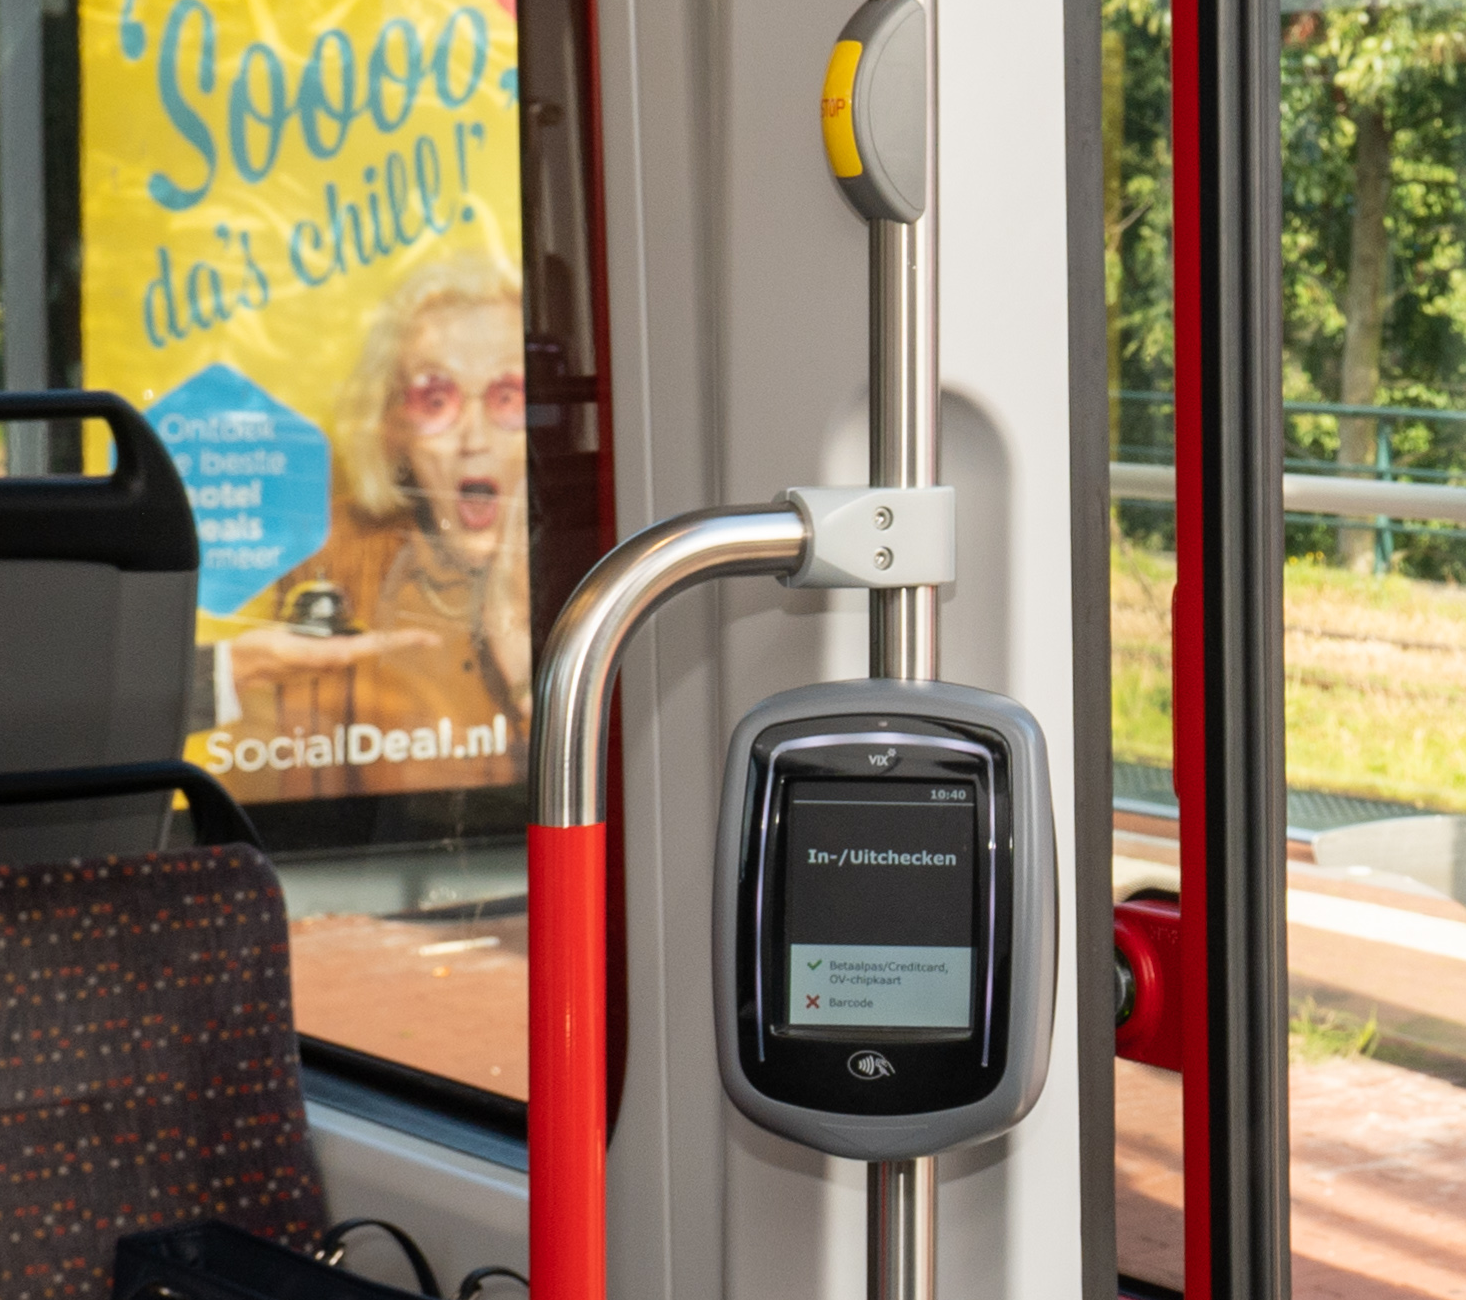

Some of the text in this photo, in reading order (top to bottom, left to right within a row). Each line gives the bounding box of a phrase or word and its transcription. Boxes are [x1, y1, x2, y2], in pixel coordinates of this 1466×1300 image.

[142, 222, 271, 350] da's
[200, 447, 287, 476] beste
[198, 512, 264, 543] eals
[203, 546, 283, 571] meer
[205, 712, 508, 775] SocialDeal.nl
[868, 754, 890, 766] VIX
[930, 788, 967, 800] 10:40
[807, 848, 957, 867] In-/Uitchecken
[829, 960, 949, 974] Betaalpas/Creditcard,
[829, 974, 902, 986] OV-chipkaart
[829, 997, 874, 1008] Barcode
